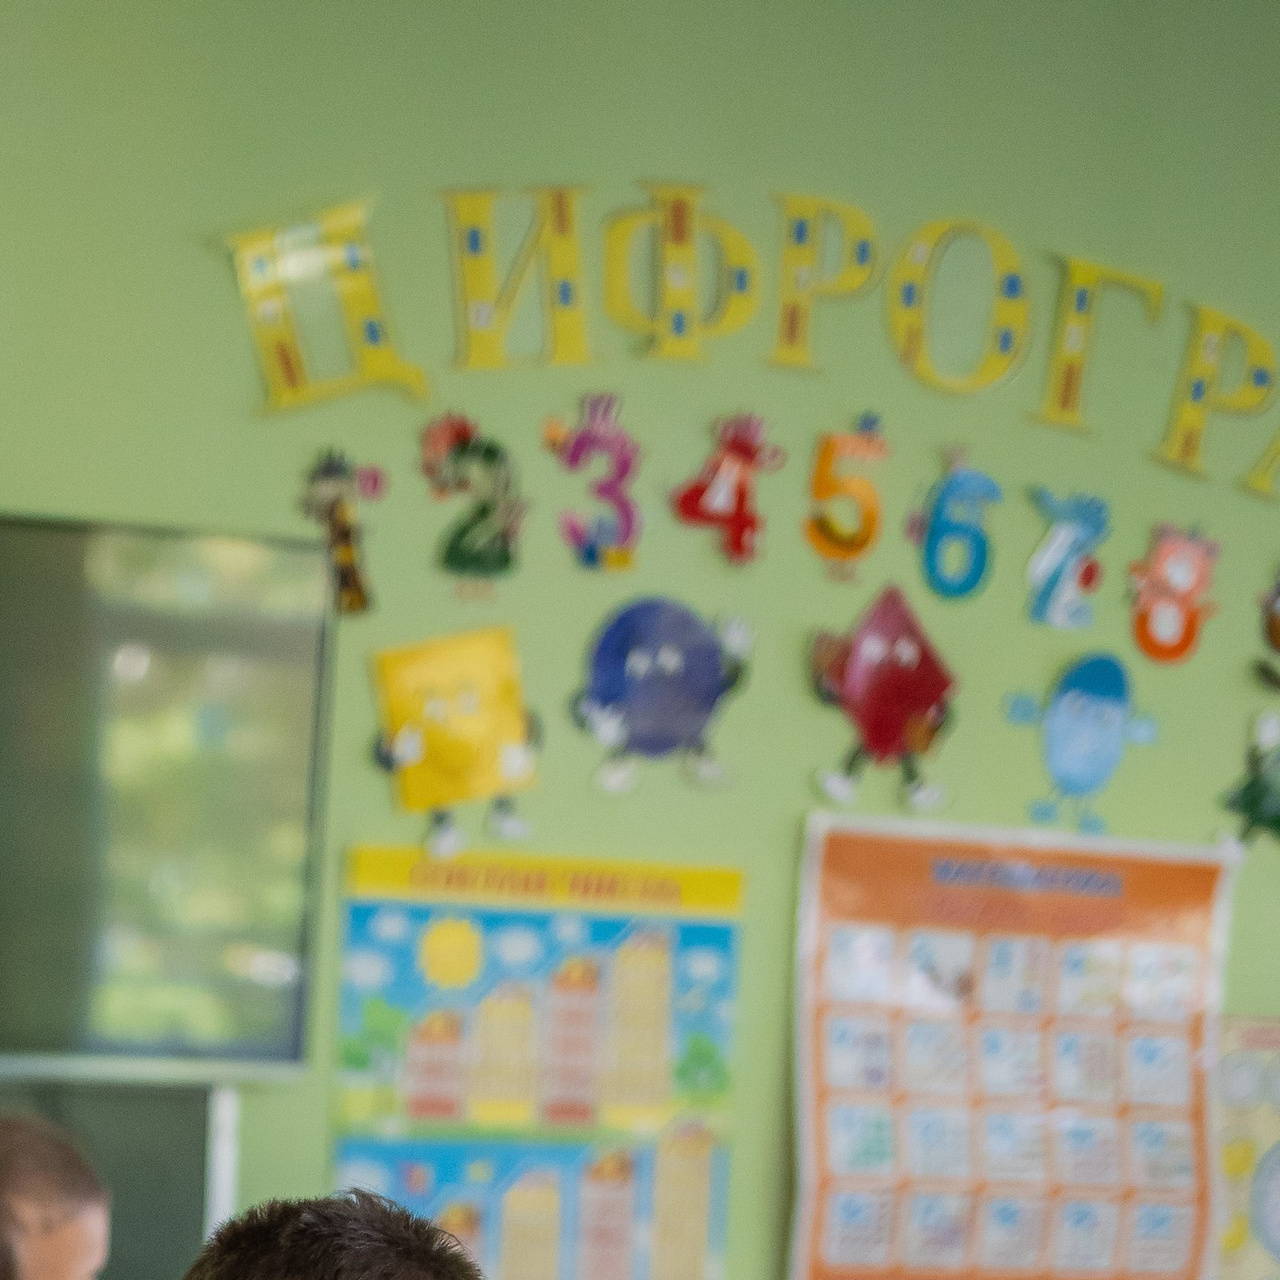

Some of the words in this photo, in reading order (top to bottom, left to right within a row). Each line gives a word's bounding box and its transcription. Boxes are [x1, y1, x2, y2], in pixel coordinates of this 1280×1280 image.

[222, 178, 1280, 502] ЦИФРОГР
[424, 420, 517, 578] 2
[558, 425, 638, 567] 3
[670, 418, 765, 565] 4
[804, 426, 892, 564] 5
[922, 465, 1004, 600] 6
[1024, 485, 1110, 630] 7
[1130, 525, 1218, 664] 8
